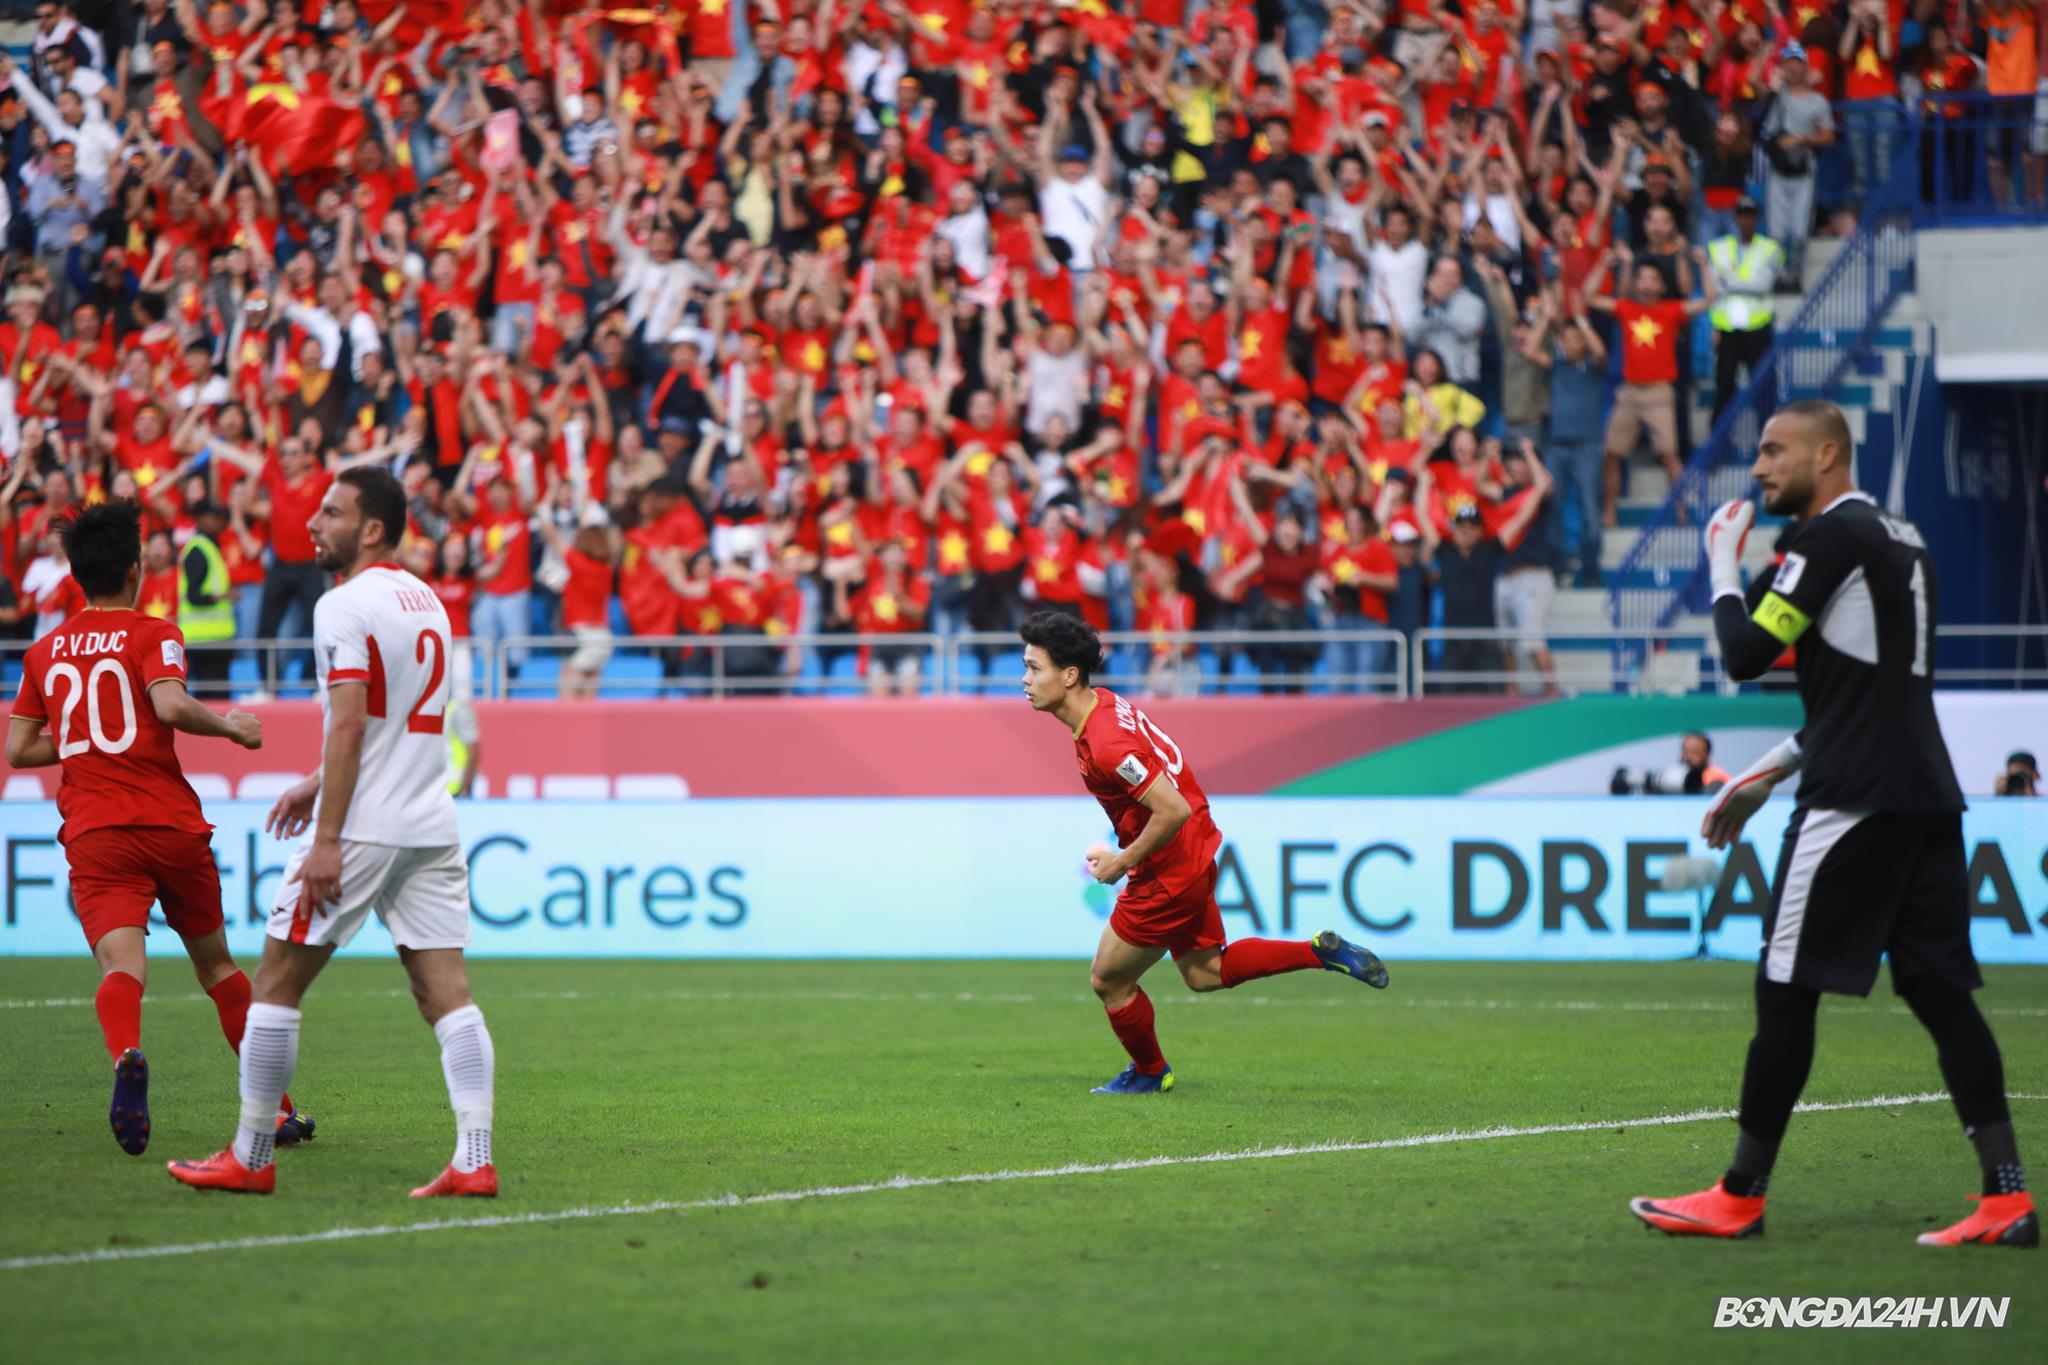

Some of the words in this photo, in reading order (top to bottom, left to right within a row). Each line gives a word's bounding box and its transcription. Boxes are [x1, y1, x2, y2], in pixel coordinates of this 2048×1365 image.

[51, 630, 128, 658] P.V.DUC
[1909, 559, 1928, 678] 1
[44, 658, 138, 760] 20
[408, 628, 446, 735] 2
[467, 834, 749, 930] Cares
[1216, 842, 1415, 932] AFC
[1452, 841, 1774, 932] DREA
